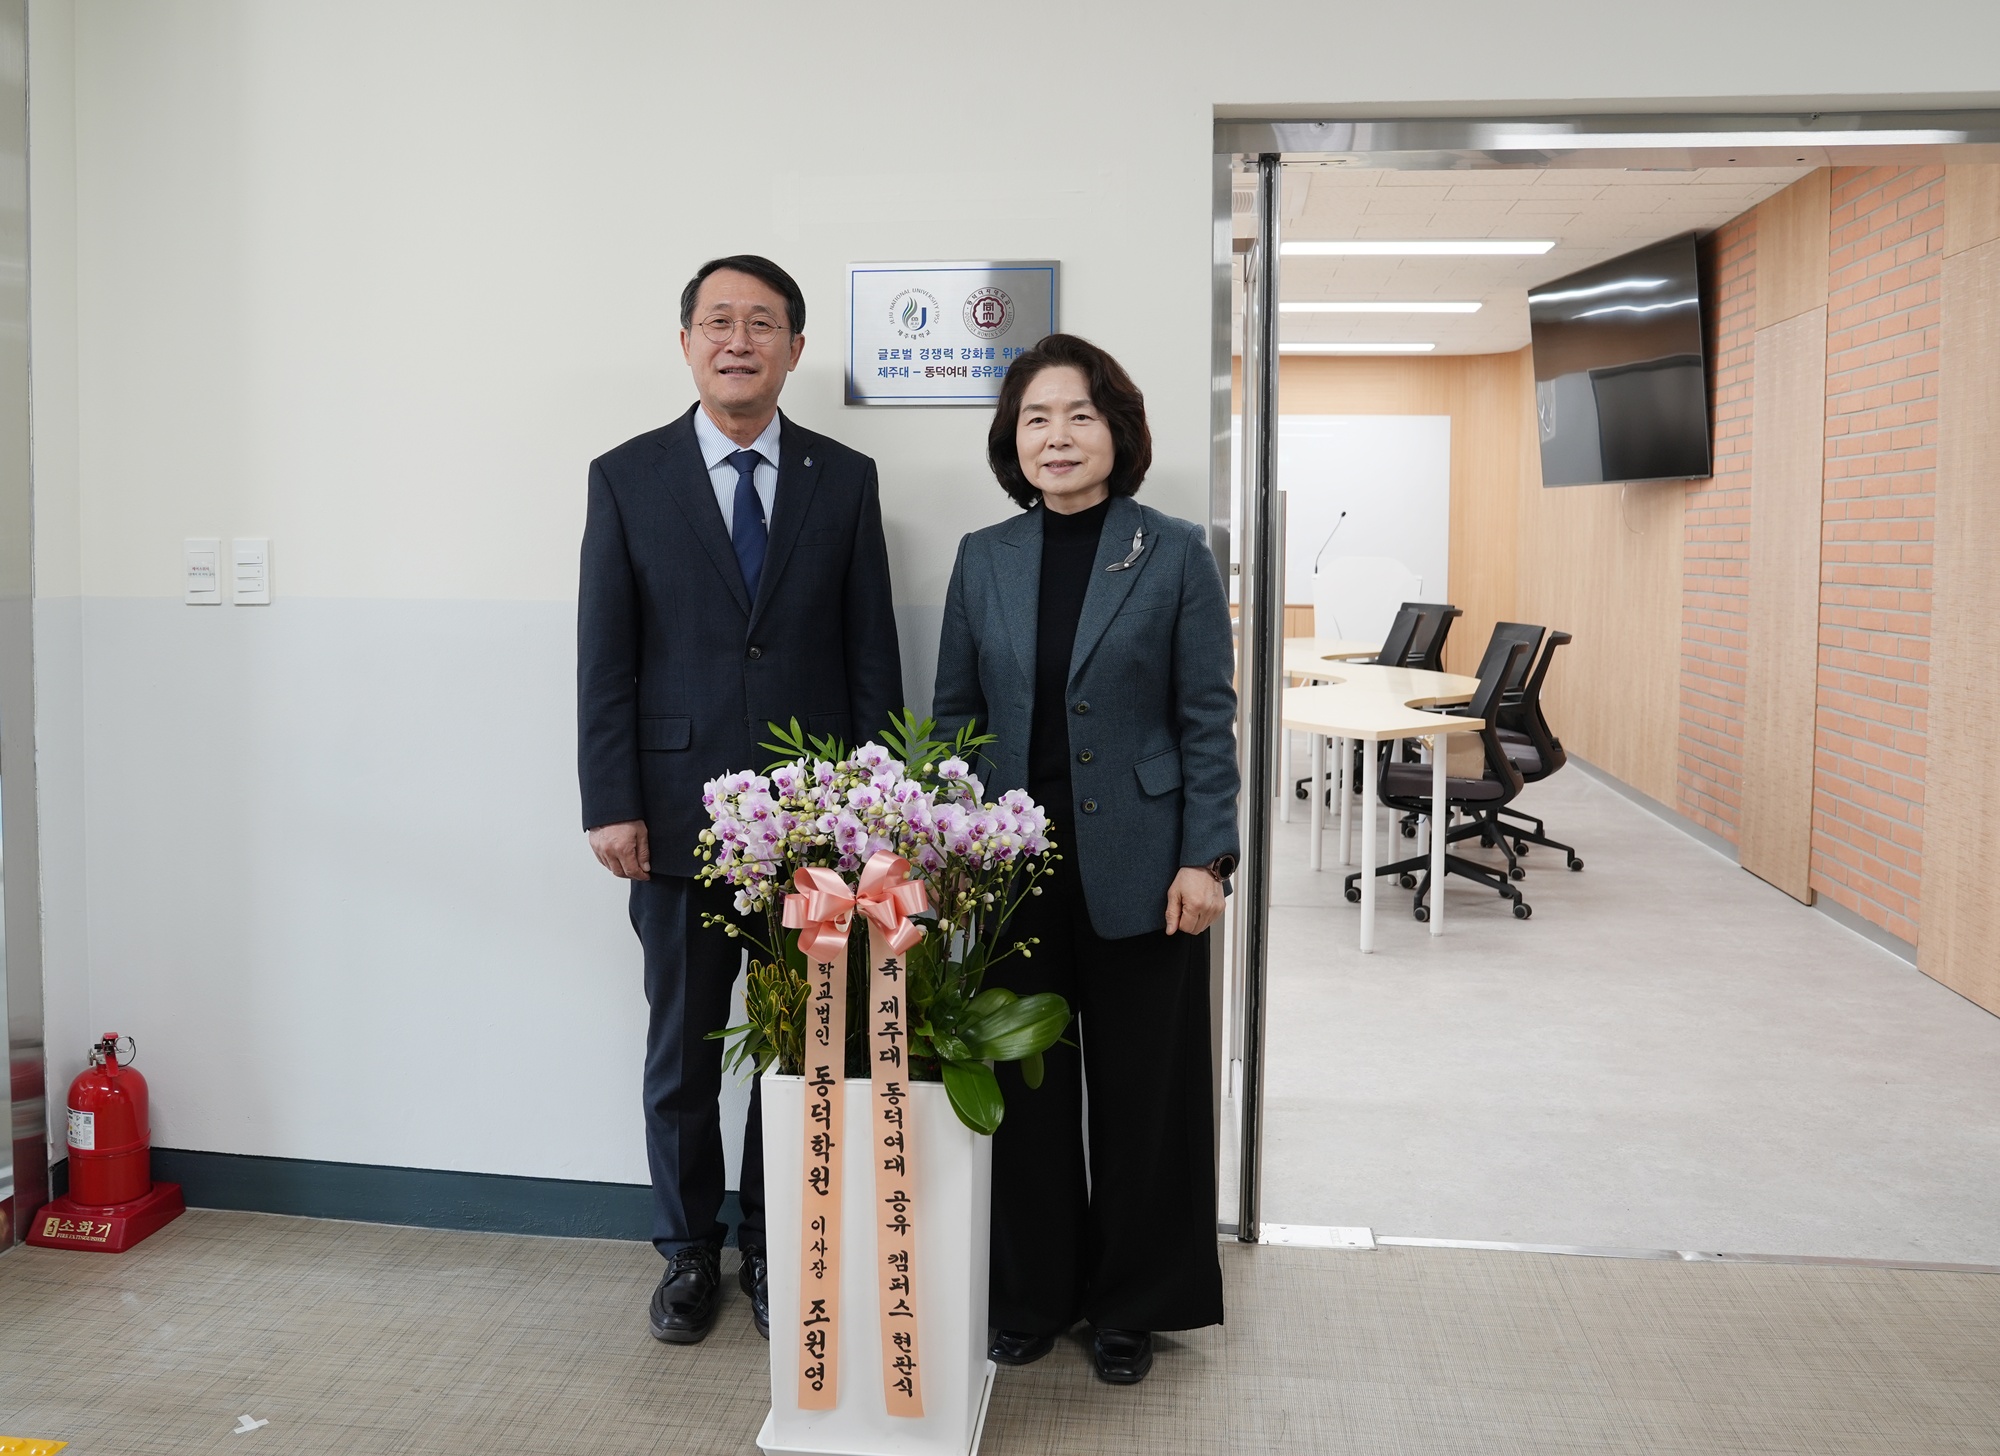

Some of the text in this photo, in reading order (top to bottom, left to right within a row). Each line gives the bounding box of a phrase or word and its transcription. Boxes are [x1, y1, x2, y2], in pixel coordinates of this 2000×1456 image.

[890, 289, 910, 310] NATIONAL
[912, 288, 940, 310] UNIVERSITY
[877, 348, 912, 361] 글로벌
[919, 347, 954, 361] 경쟁력
[960, 347, 996, 360] 강화를
[877, 366, 909, 378] 제주대
[924, 366, 967, 378] 동덕여대
[803, 961, 836, 1392] 학교법인 동덕학원 이사장 조원영
[877, 958, 917, 1398] 축 제주대 동덕여대 공유 캠퍼스 현판식
[58, 1219, 112, 1238] 소화기
